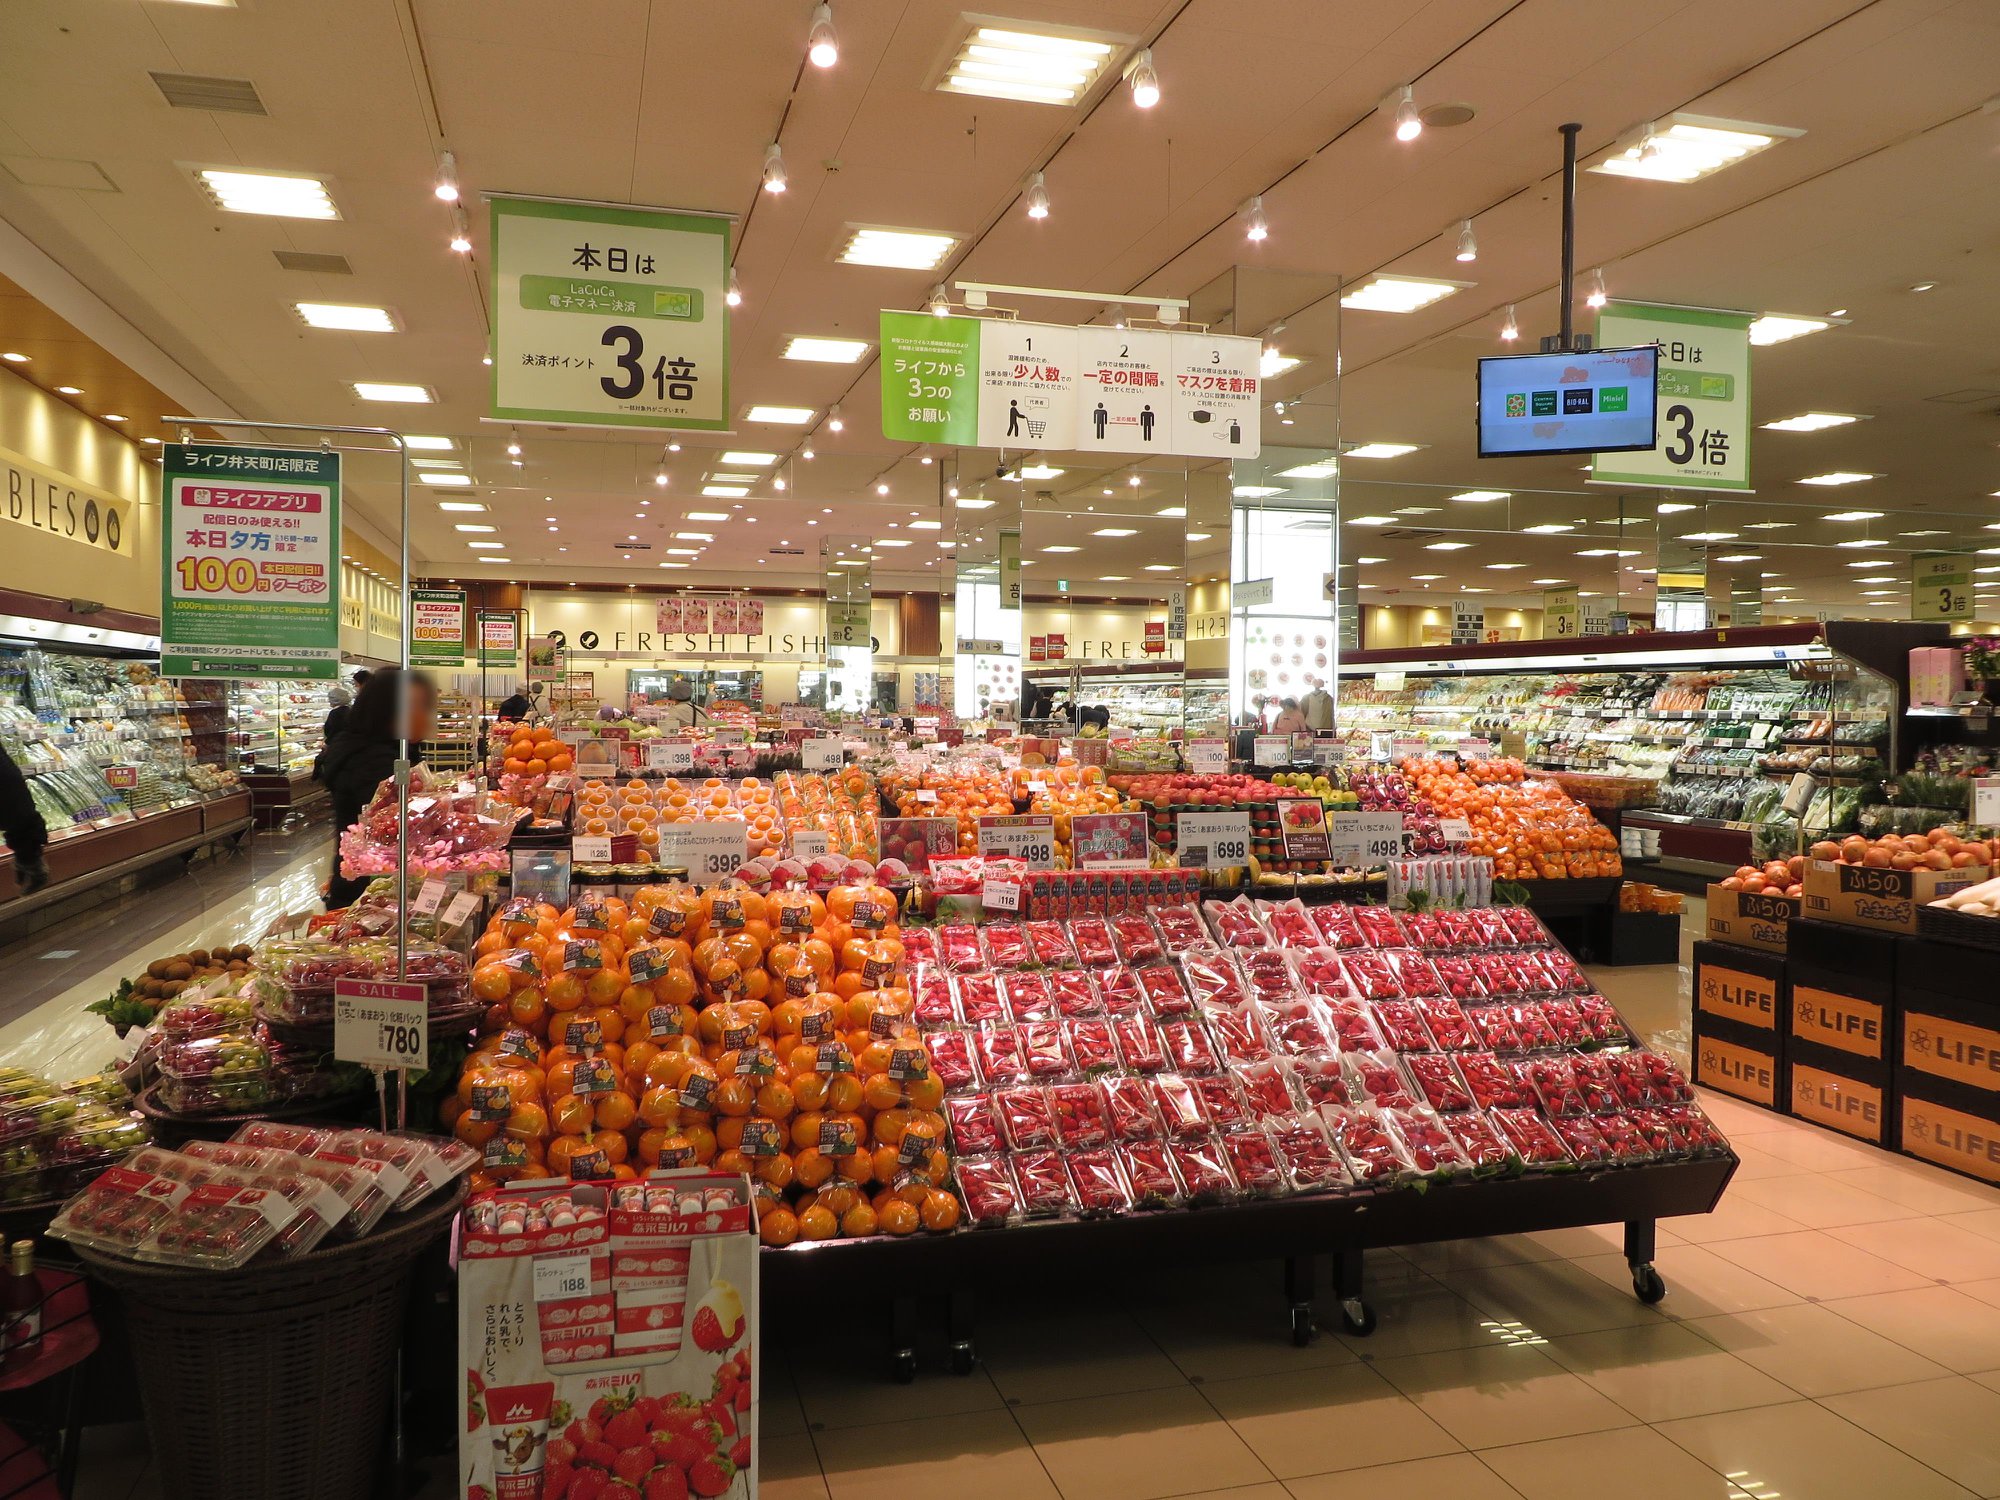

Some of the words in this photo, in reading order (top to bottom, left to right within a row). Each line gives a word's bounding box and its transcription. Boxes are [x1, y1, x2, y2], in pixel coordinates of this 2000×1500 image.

[571, 242, 656, 275] 本日は
[570, 283, 616, 298] LaCuCa
[548, 294, 637, 314] 電子マネー決済
[1025, 337, 1032, 351] 1
[1120, 344, 1129, 358] 2
[521, 353, 595, 370] 決済ポイント
[600, 325, 698, 401] 3倍
[1212, 350, 1220, 364] 3
[894, 359, 966, 377] ライフから
[908, 377, 952, 399] 3つの
[1176, 374, 1257, 394] マスクを着用
[908, 407, 951, 423] お願い
[1665, 404, 1730, 466] 3倍
[184, 451, 320, 474] ライフ弁天町店限定
[0, 467, 76, 537] BLES
[215, 491, 308, 510] ライフアプリ
[1173, 592, 1180, 604] 8
[1453, 601, 1465, 613] 10
[1939, 588, 1967, 612] 3倍
[1582, 605, 1591, 616] 11
[615, 630, 726, 653] FRESH
[675, 754, 691, 764] 398
[826, 754, 841, 764] 498
[1210, 753, 1223, 762] 100
[811, 846, 825, 854] 158
[1021, 844, 1050, 862] 498
[1217, 841, 1245, 858] 698
[1371, 840, 1398, 857] 498
[709, 854, 741, 874] 398
[1850, 868, 1900, 893] ふらの
[1001, 896, 1015, 905] 118
[1746, 896, 1791, 917] ふらの
[1854, 898, 1913, 924] たまねぎ
[1751, 923, 1788, 945] たまね
[360, 984, 400, 998] SALE
[1722, 984, 1771, 1013] LIFE
[1820, 1008, 1877, 1041] LIFE
[384, 1025, 420, 1055] 780
[1937, 1036, 2000, 1073] LIFE
[1721, 1056, 1770, 1088] LIFE
[1820, 1085, 1877, 1124] LIFE
[632, 1222, 688, 1234] 森永ミルク
[563, 1277, 585, 1292] 188
[485, 1304, 497, 1383] さらにおいしく。
[585, 1372, 641, 1390] 森永ミルク
